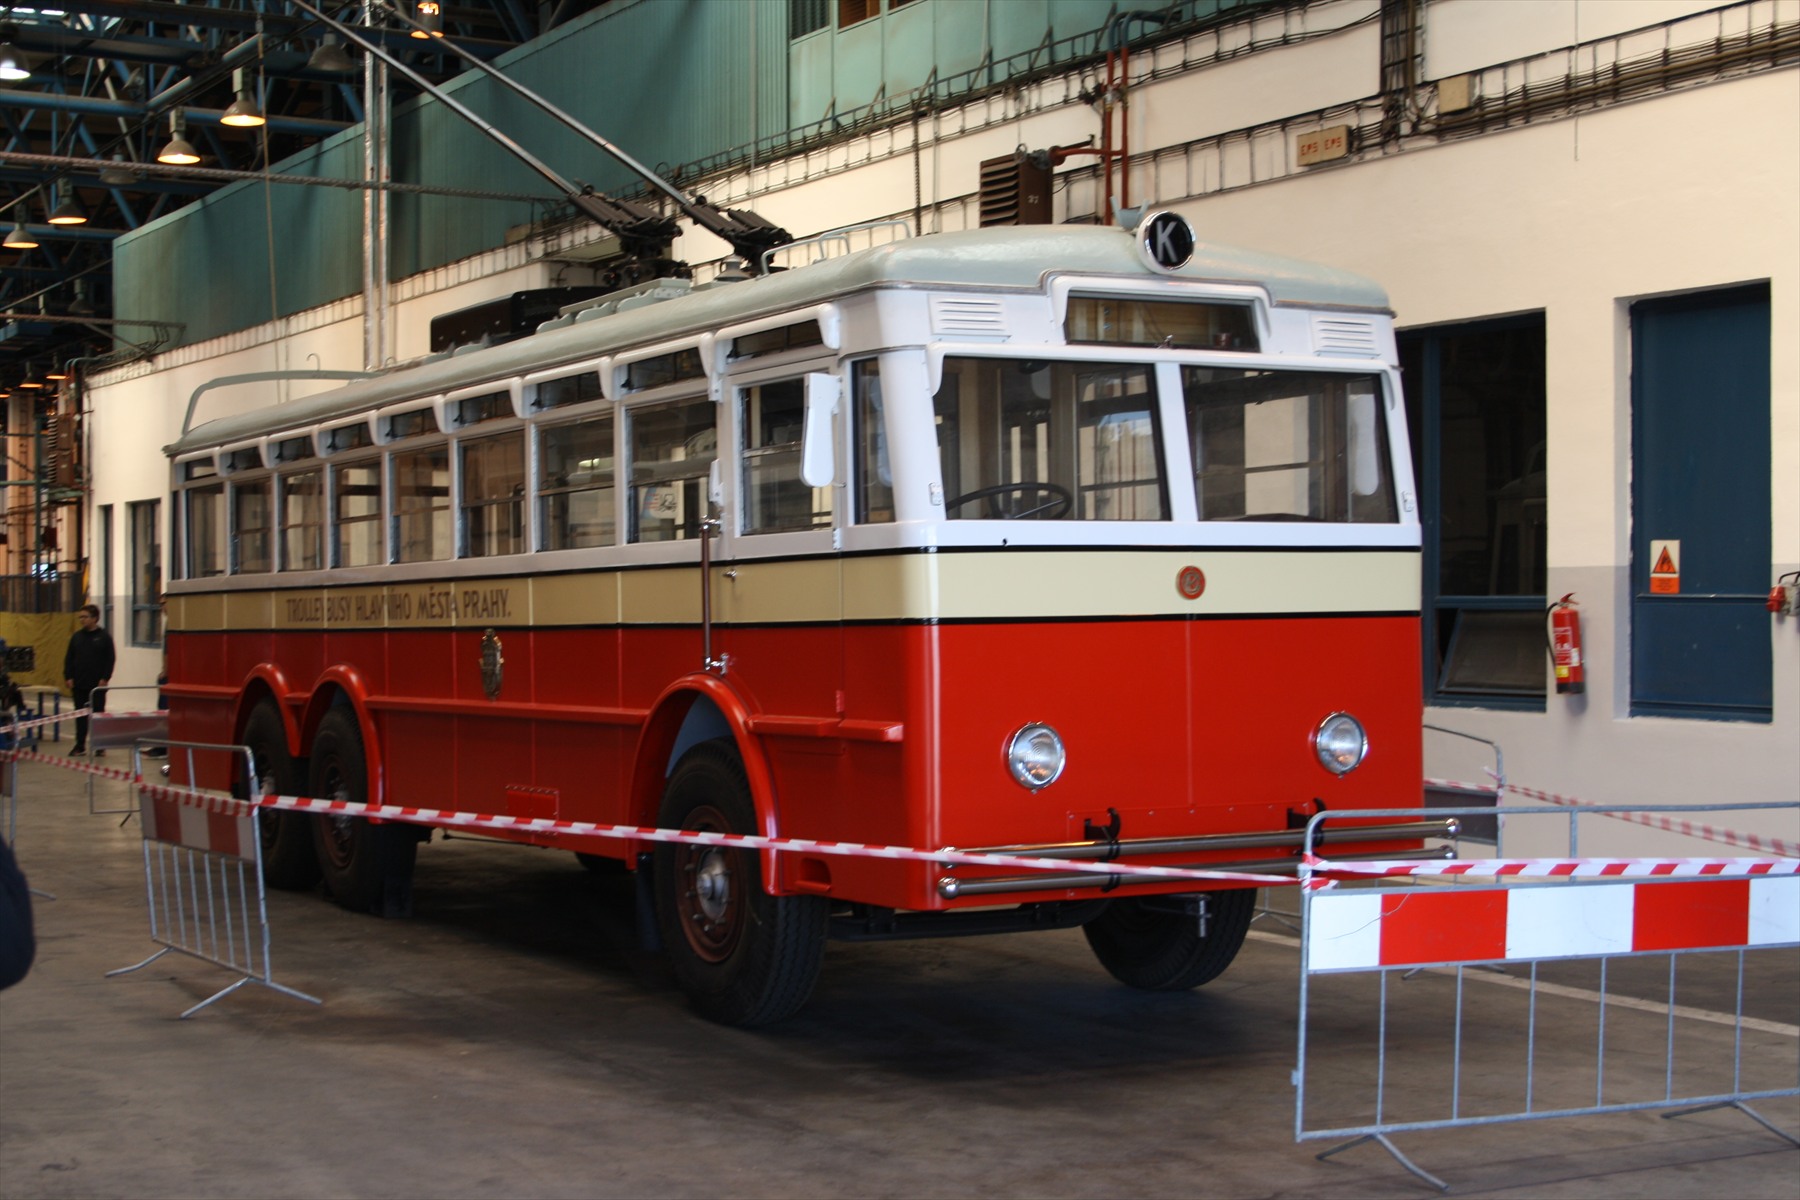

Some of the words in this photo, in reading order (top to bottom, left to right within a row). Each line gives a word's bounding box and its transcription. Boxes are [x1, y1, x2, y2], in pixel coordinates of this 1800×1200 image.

[1156, 220, 1178, 263] K
[417, 586, 459, 620] MĚSTA
[463, 588, 512, 619] PRAHY.
